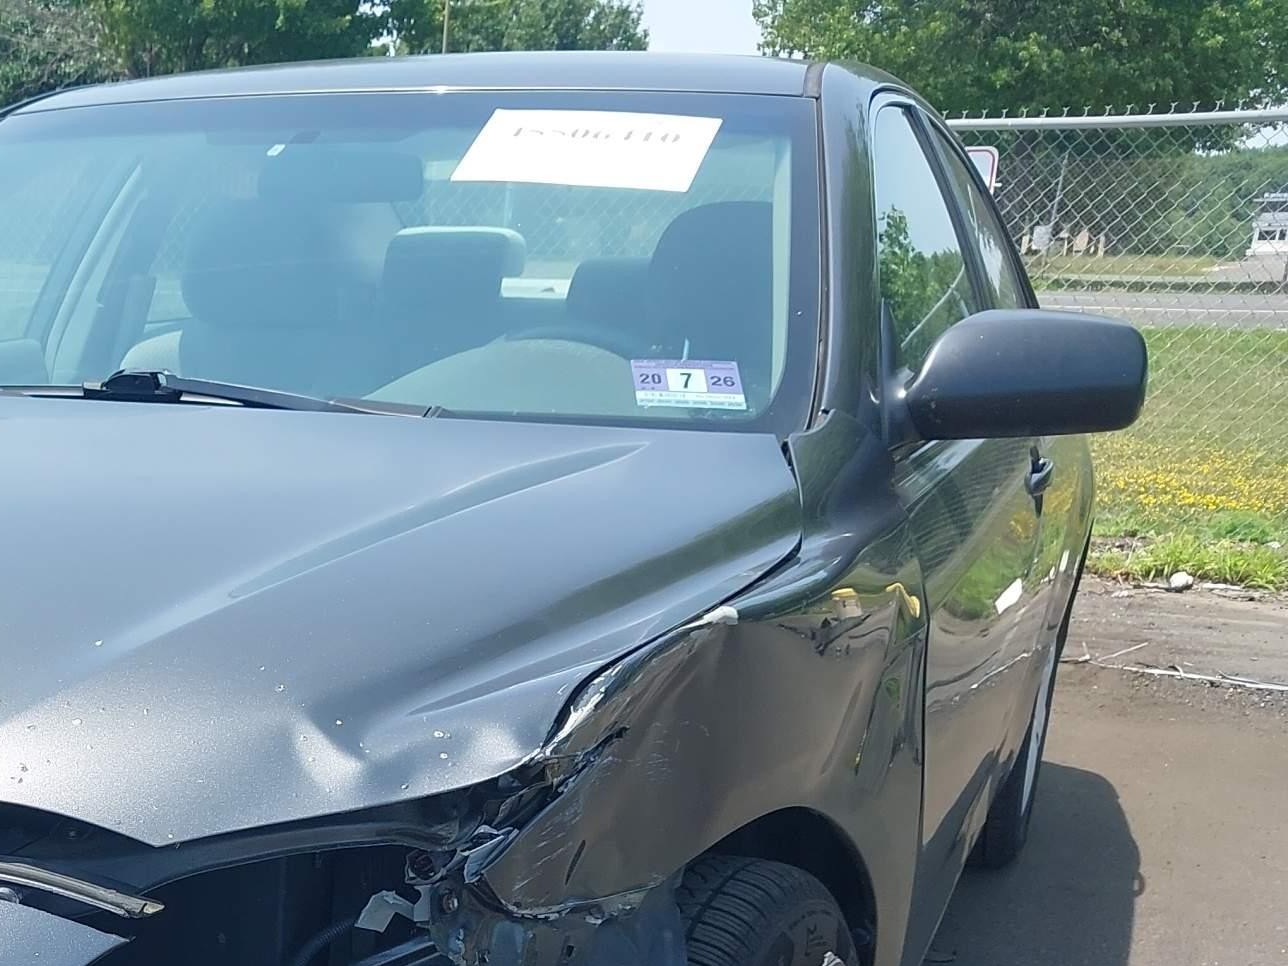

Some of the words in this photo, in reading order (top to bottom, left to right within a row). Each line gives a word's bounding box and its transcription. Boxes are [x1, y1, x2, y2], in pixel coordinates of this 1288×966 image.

[638, 372, 662, 385] 20
[679, 372, 693, 389] 7
[710, 375, 737, 388] 26
